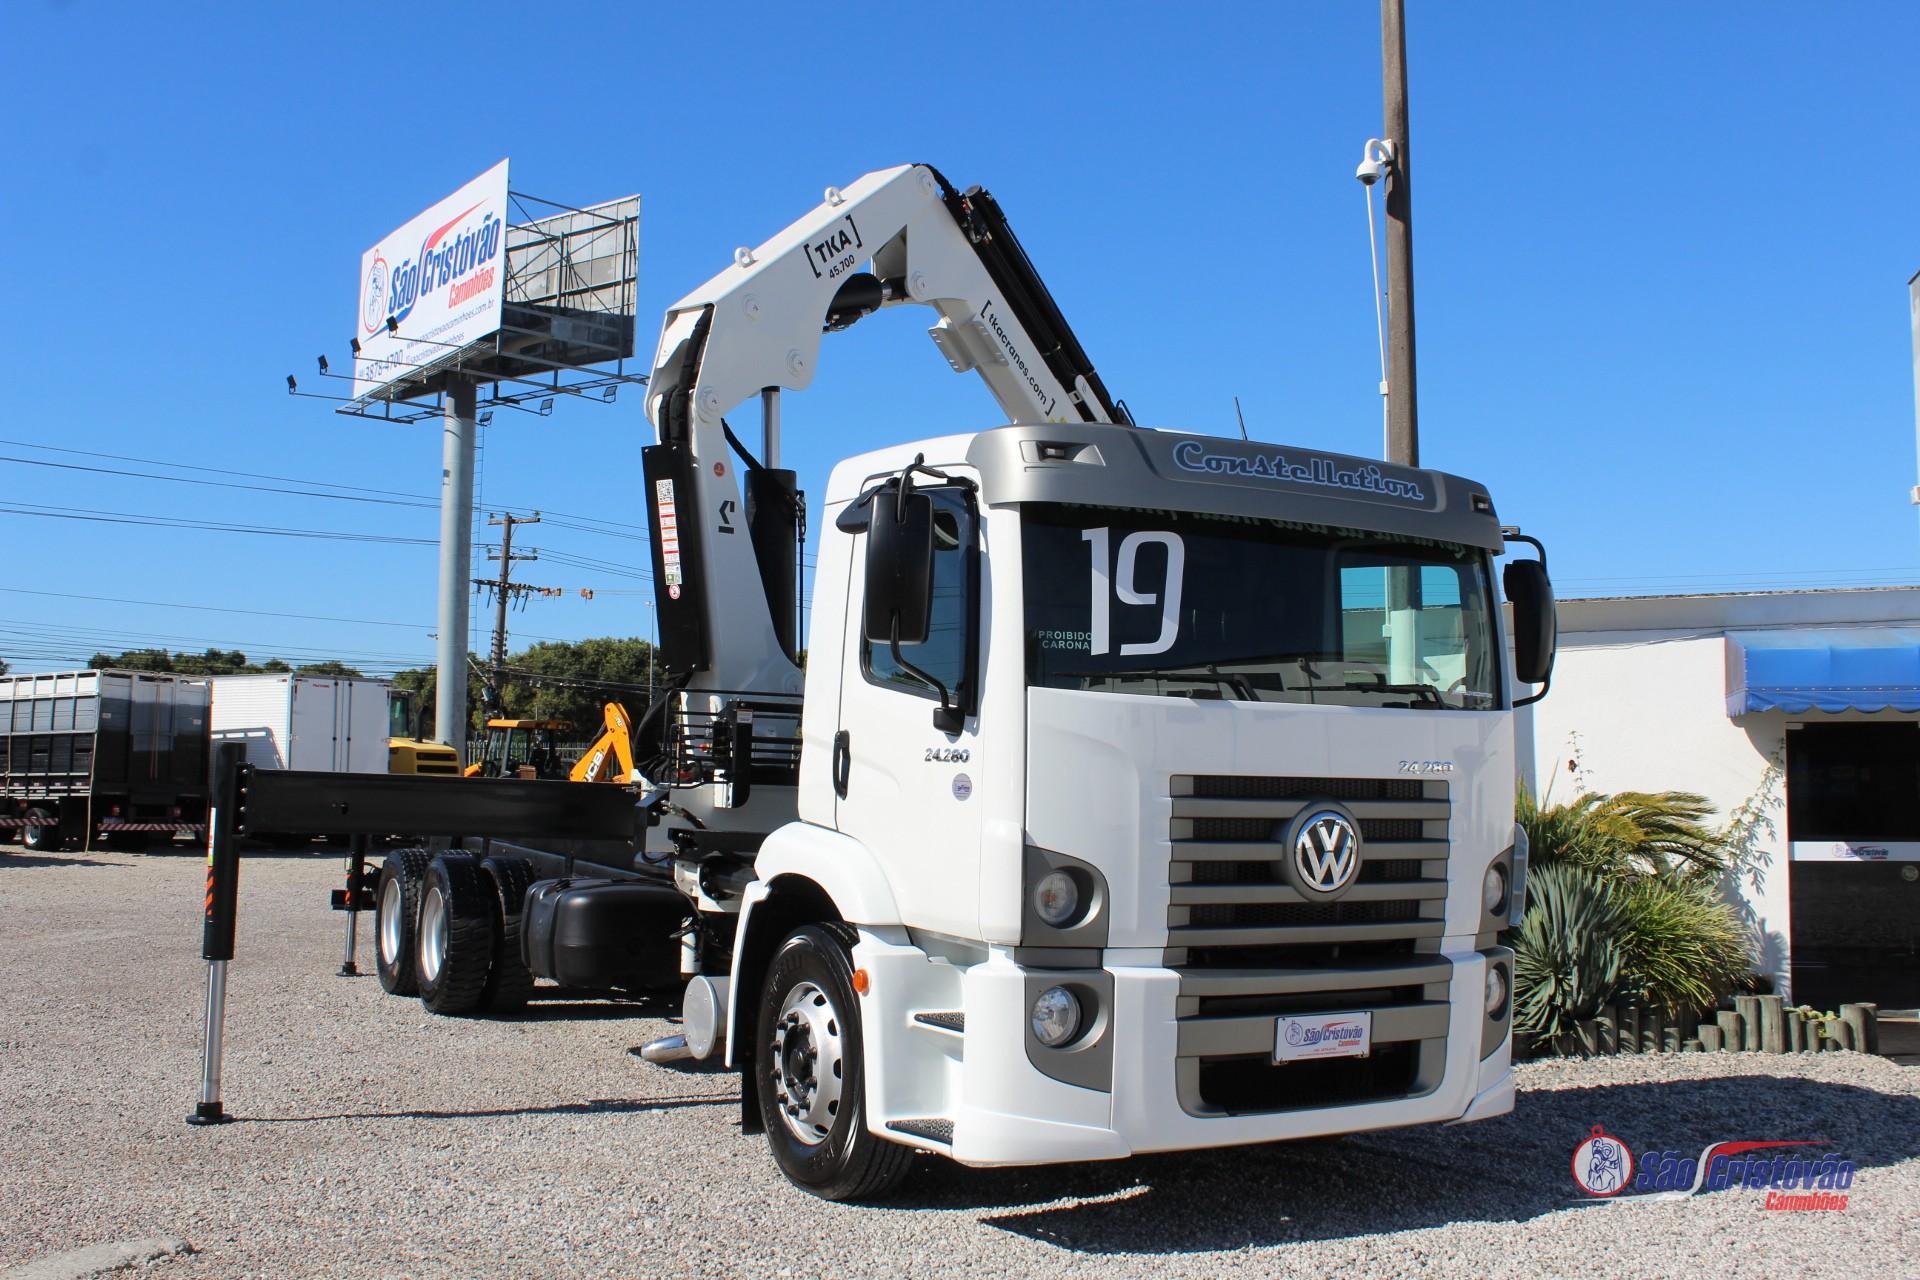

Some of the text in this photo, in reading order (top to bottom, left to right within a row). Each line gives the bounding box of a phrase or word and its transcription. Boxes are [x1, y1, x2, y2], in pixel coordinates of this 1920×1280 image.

[389, 211, 500, 314] São Cristóvão
[829, 254, 855, 279] 45.700
[1172, 440, 1424, 501] Constellation
[1081, 526, 1185, 656] 19
[1038, 630, 1092, 641] PROIBIDO
[1042, 640, 1090, 650] CARONA
